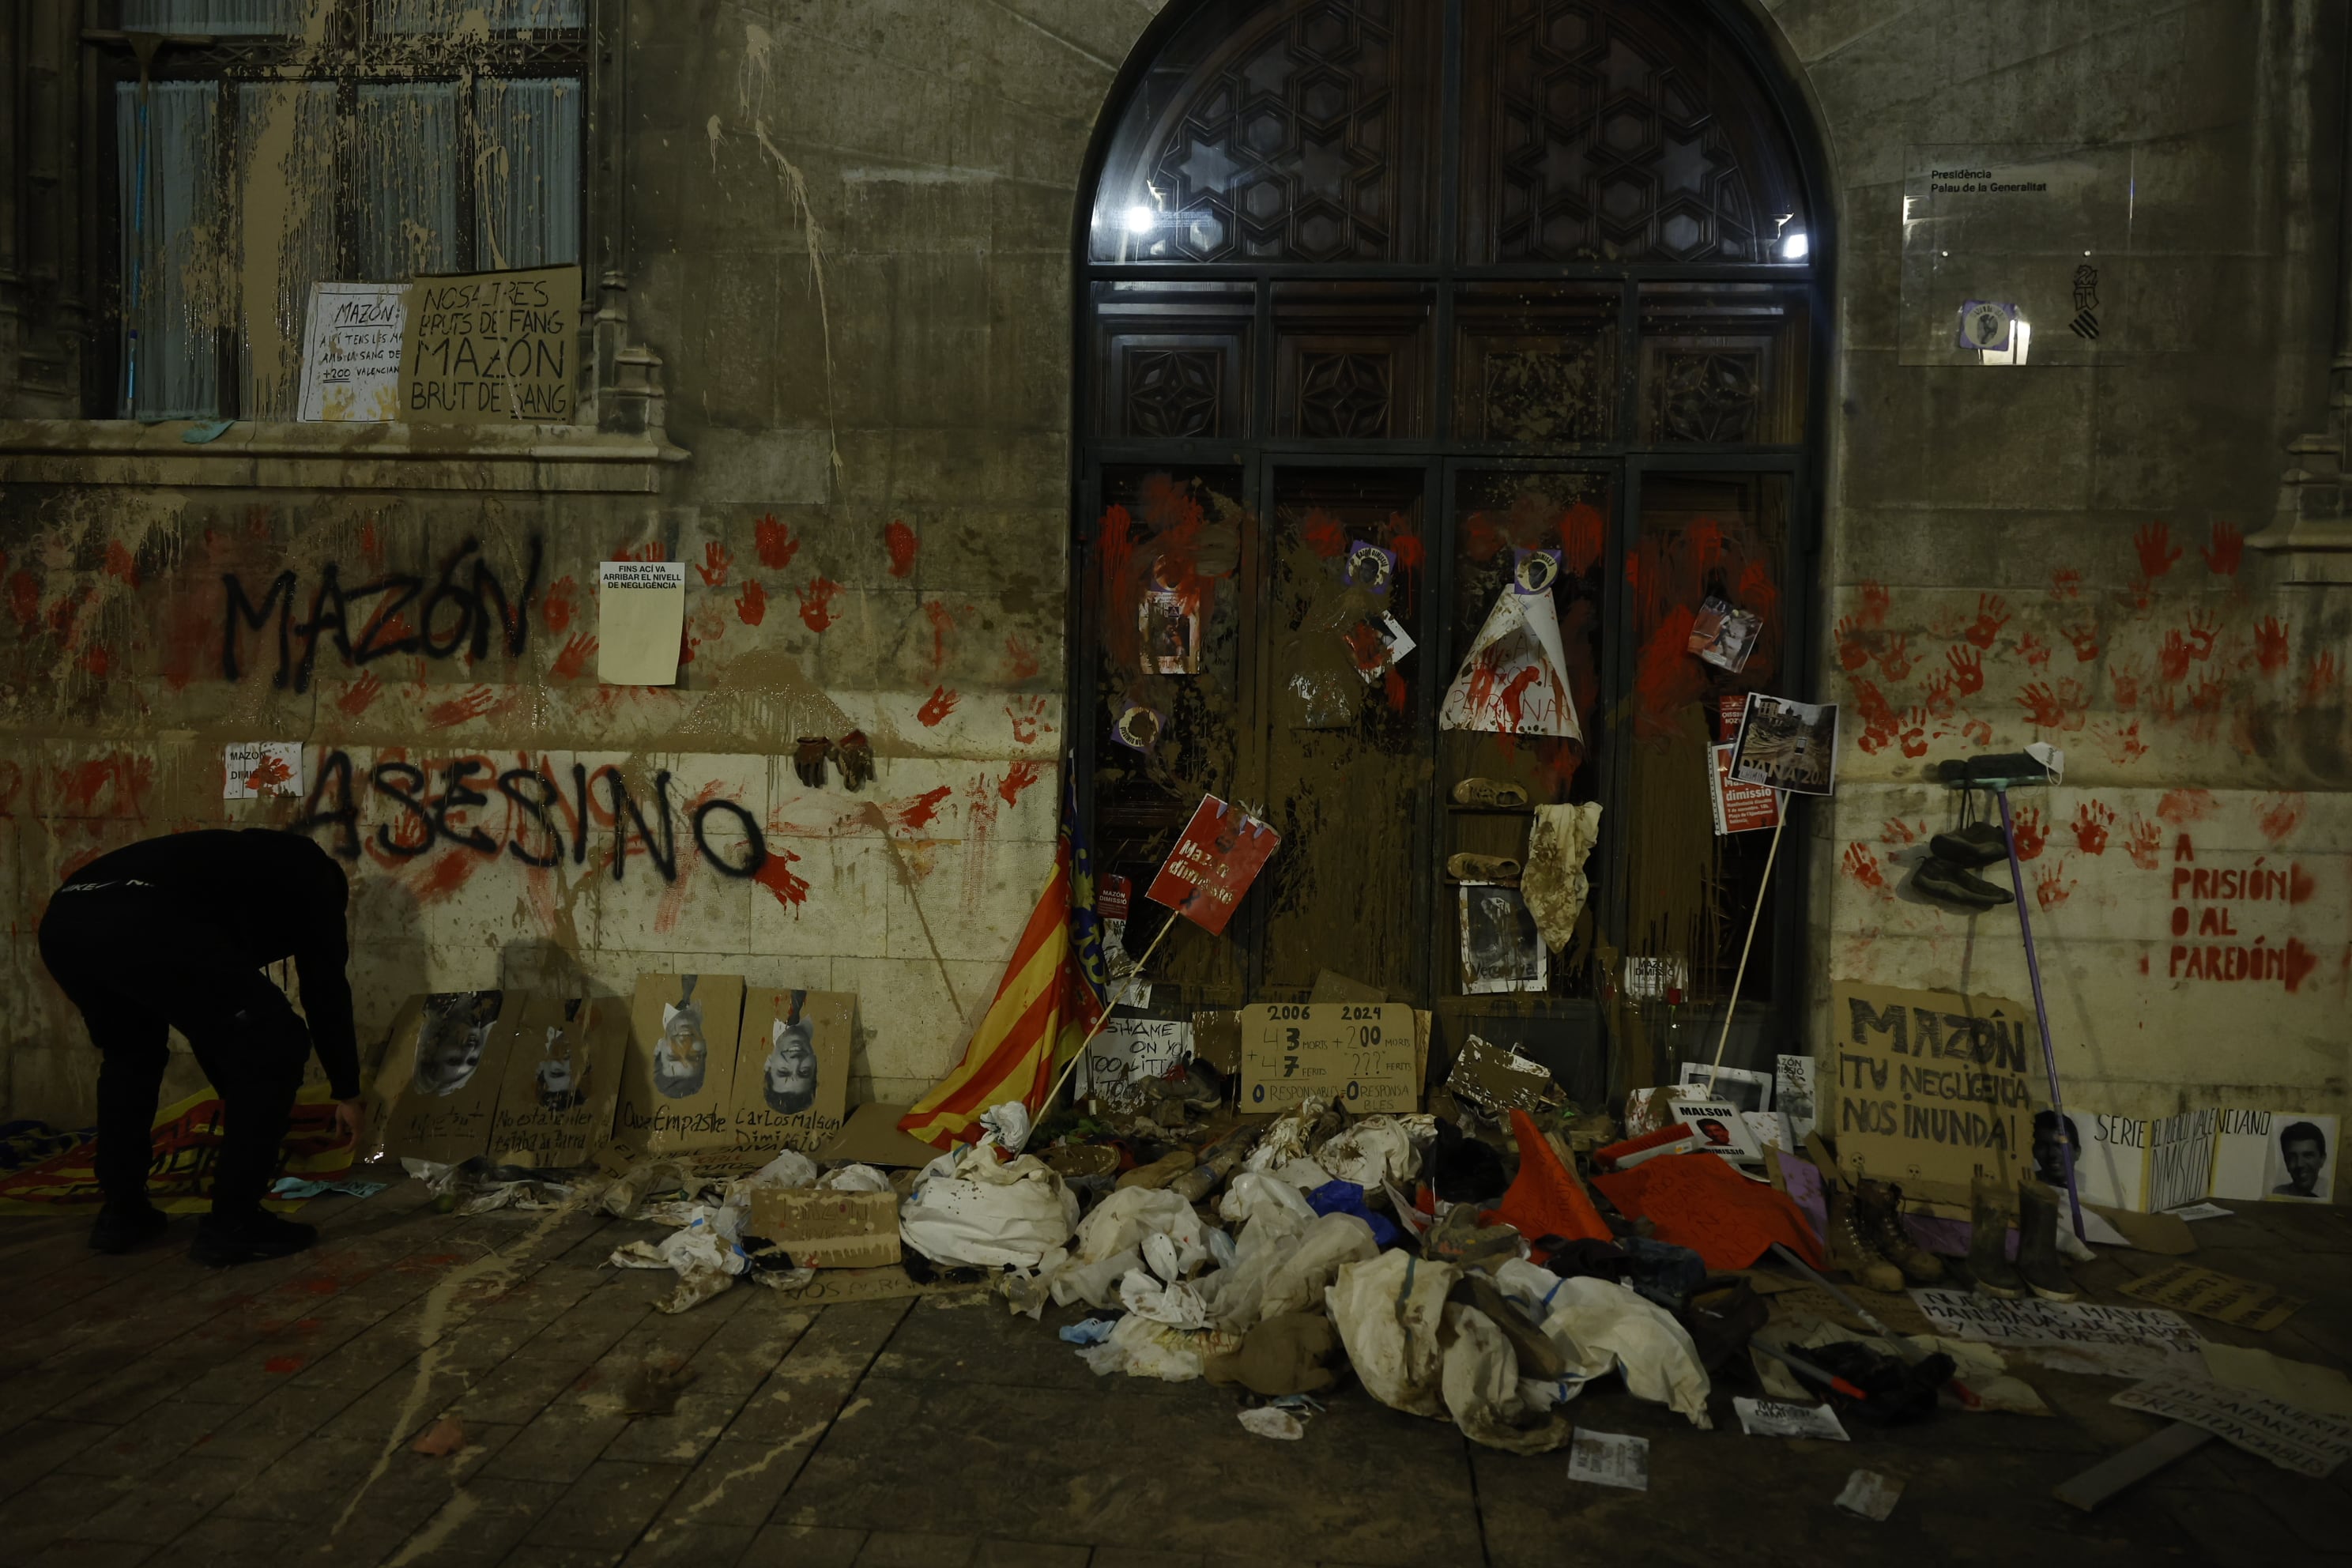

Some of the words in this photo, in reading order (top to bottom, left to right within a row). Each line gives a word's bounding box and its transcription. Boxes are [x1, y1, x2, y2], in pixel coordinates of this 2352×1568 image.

[1931, 169, 1992, 179] Presidència
[1931, 183, 1960, 193] Palau
[1962, 183, 1976, 193] de
[1978, 183, 1987, 192] la
[1990, 182, 2047, 192] Generalitat
[508, 309, 564, 334] FANG
[345, 334, 369, 345] TENS
[360, 350, 384, 360] SANG
[413, 332, 565, 379] MAZÓN
[322, 368, 351, 379] +200
[411, 381, 473, 411] BRUT
[477, 382, 501, 412] DE
[639, 564, 654, 573] ACÍ
[221, 533, 541, 693] MAZÓN
[283, 749, 767, 882] ASESINO
[2174, 833, 2194, 861] A
[2171, 855, 2287, 901] PRISIÓN
[2171, 906, 2189, 937] O
[2199, 906, 2237, 937] AL
[2169, 934, 2286, 982] PAREDÓN
[1267, 1005, 1311, 1021] 2006
[1341, 1006, 1381, 1020] 2024
[1106, 1018, 1177, 1038] SHAME
[1849, 997, 2027, 1073] MAZÓN
[1129, 1040, 1157, 1054] ON
[1253, 1084, 1265, 1103] 0
[1679, 1106, 1733, 1117] MALSON
[1842, 1096, 1898, 1136] NOS
[2193, 1107, 2271, 1136] VALENCIANO
